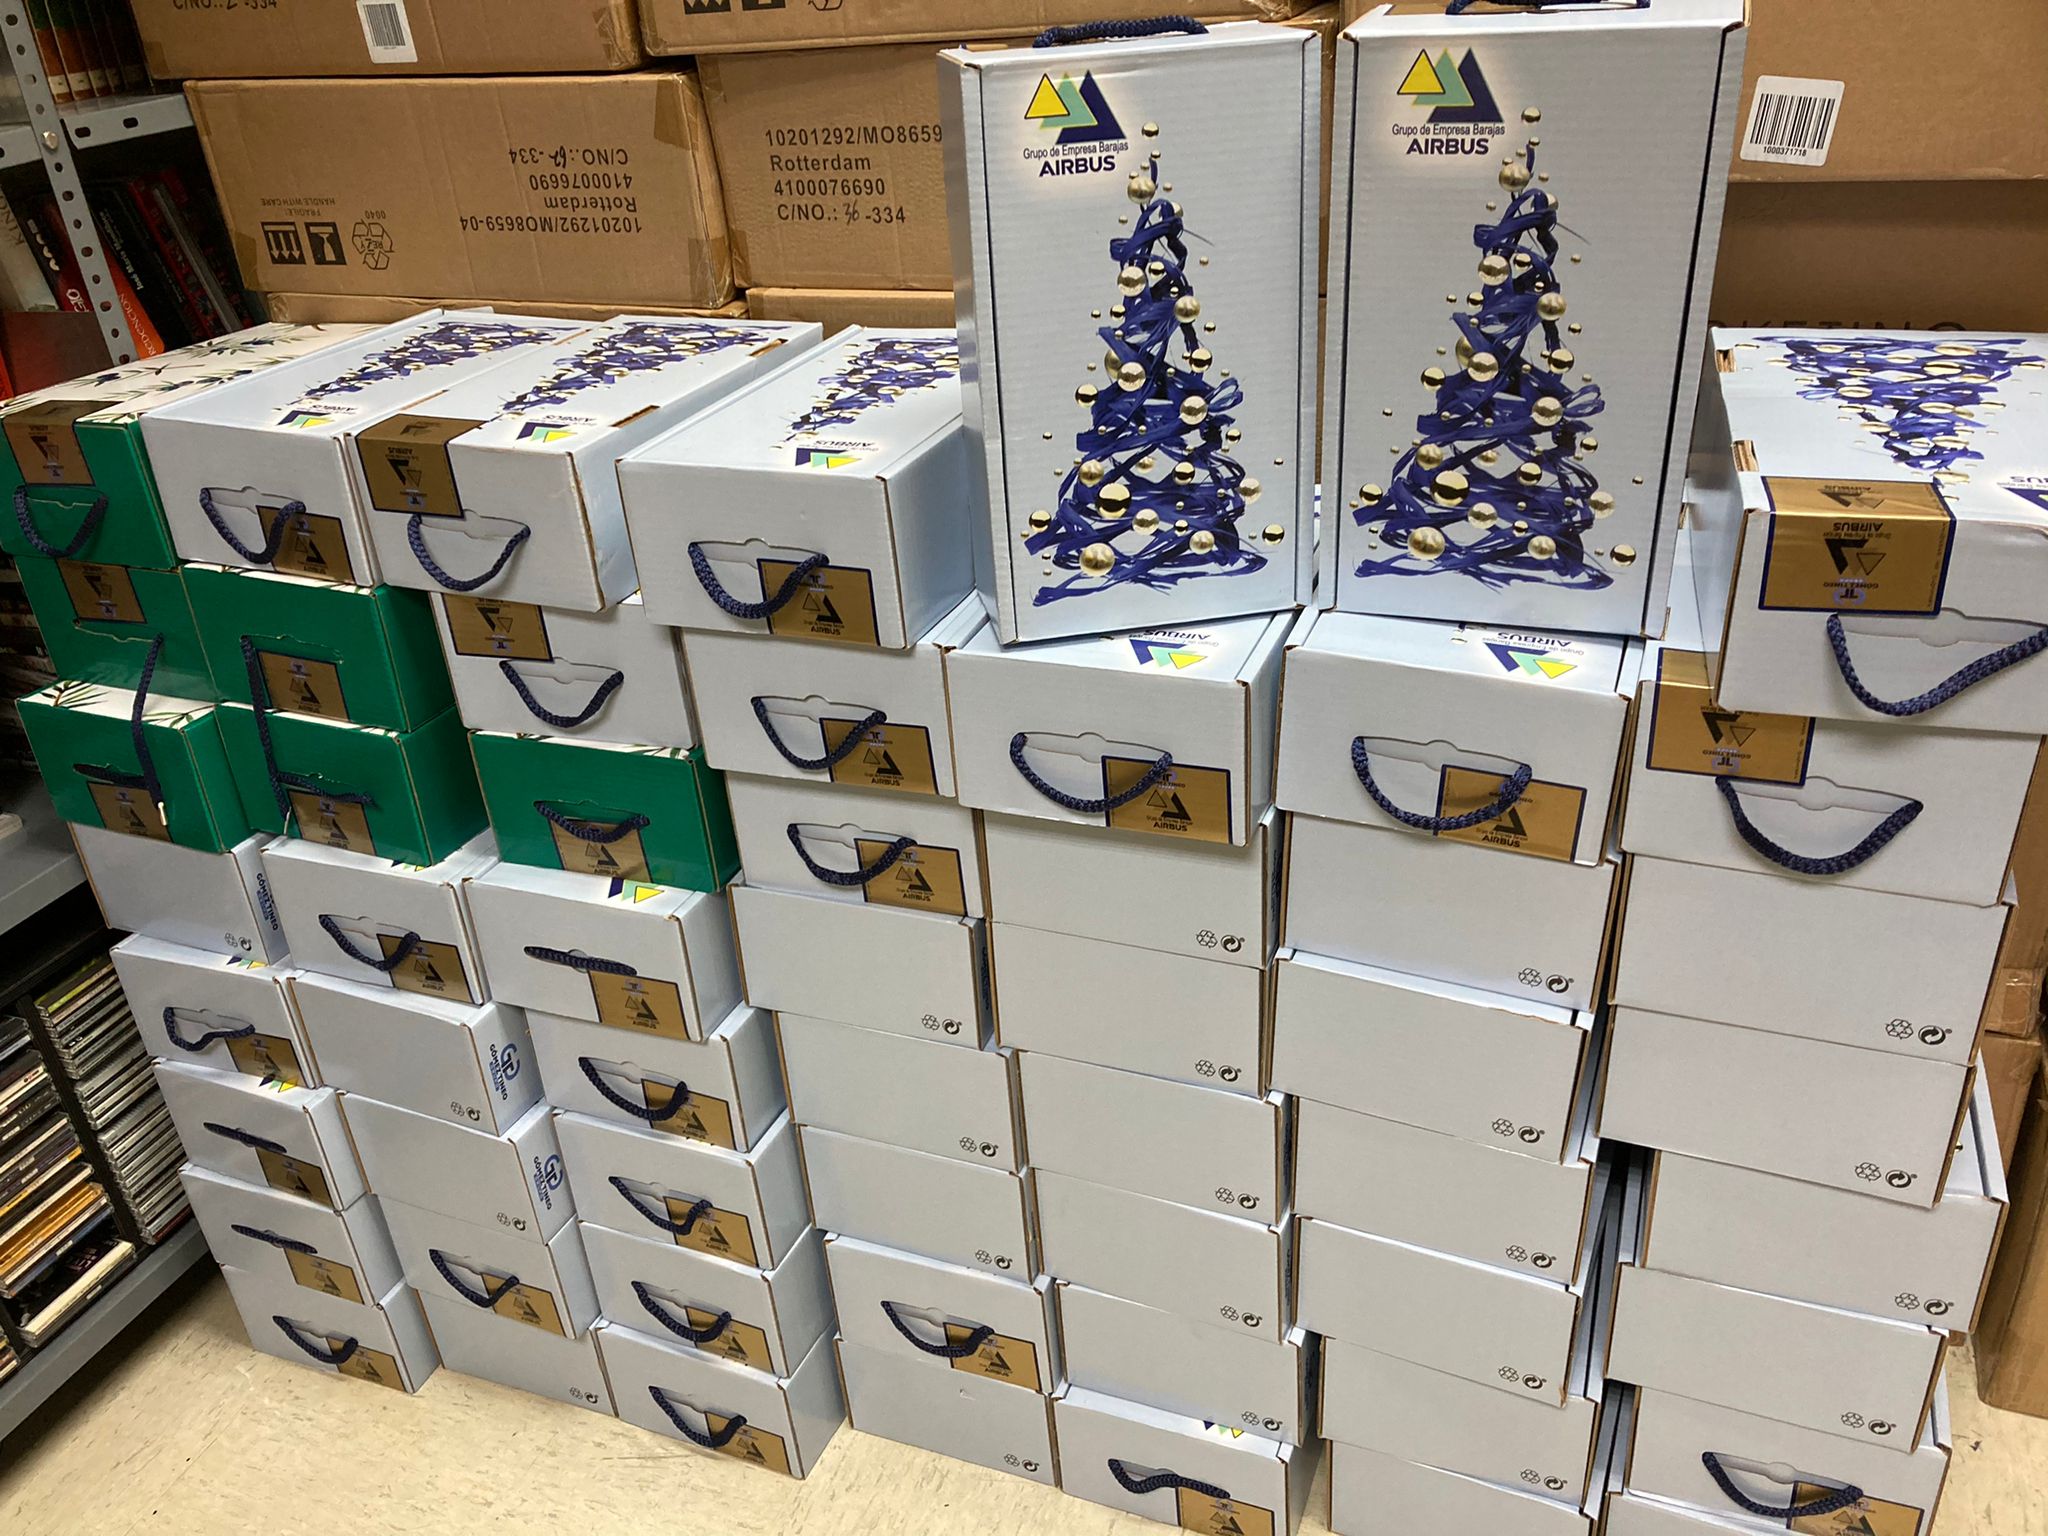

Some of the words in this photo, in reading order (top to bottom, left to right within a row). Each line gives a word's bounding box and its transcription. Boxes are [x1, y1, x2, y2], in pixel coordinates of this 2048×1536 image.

[1391, 123, 1418, 137] Grupo
[1420, 123, 1430, 135] de
[1433, 123, 1470, 137] Empresa
[1473, 123, 1505, 137] Barajas
[1023, 147, 1048, 160] Grupo
[1049, 146, 1060, 157] de
[1062, 143, 1097, 157] Empresa
[1099, 141, 1129, 154] Barajas
[1406, 138, 1489, 155] AIRBUS
[770, 154, 871, 172] Rotterdam
[1039, 155, 1115, 177] AIRBUS
[529, 173, 632, 190] 4100076690
[774, 178, 885, 197] 4100076690
[544, 197, 637, 212] Rotterdam
[364, 210, 386, 220] 0040
[459, 216, 642, 233] 10201292/MO8659-04
[1832, 521, 1884, 533] AIRBUS
[1497, 632, 1573, 648] AIRBUS
[1153, 820, 1188, 832] AIRBUS
[1481, 833, 1521, 848] AIRBUS
